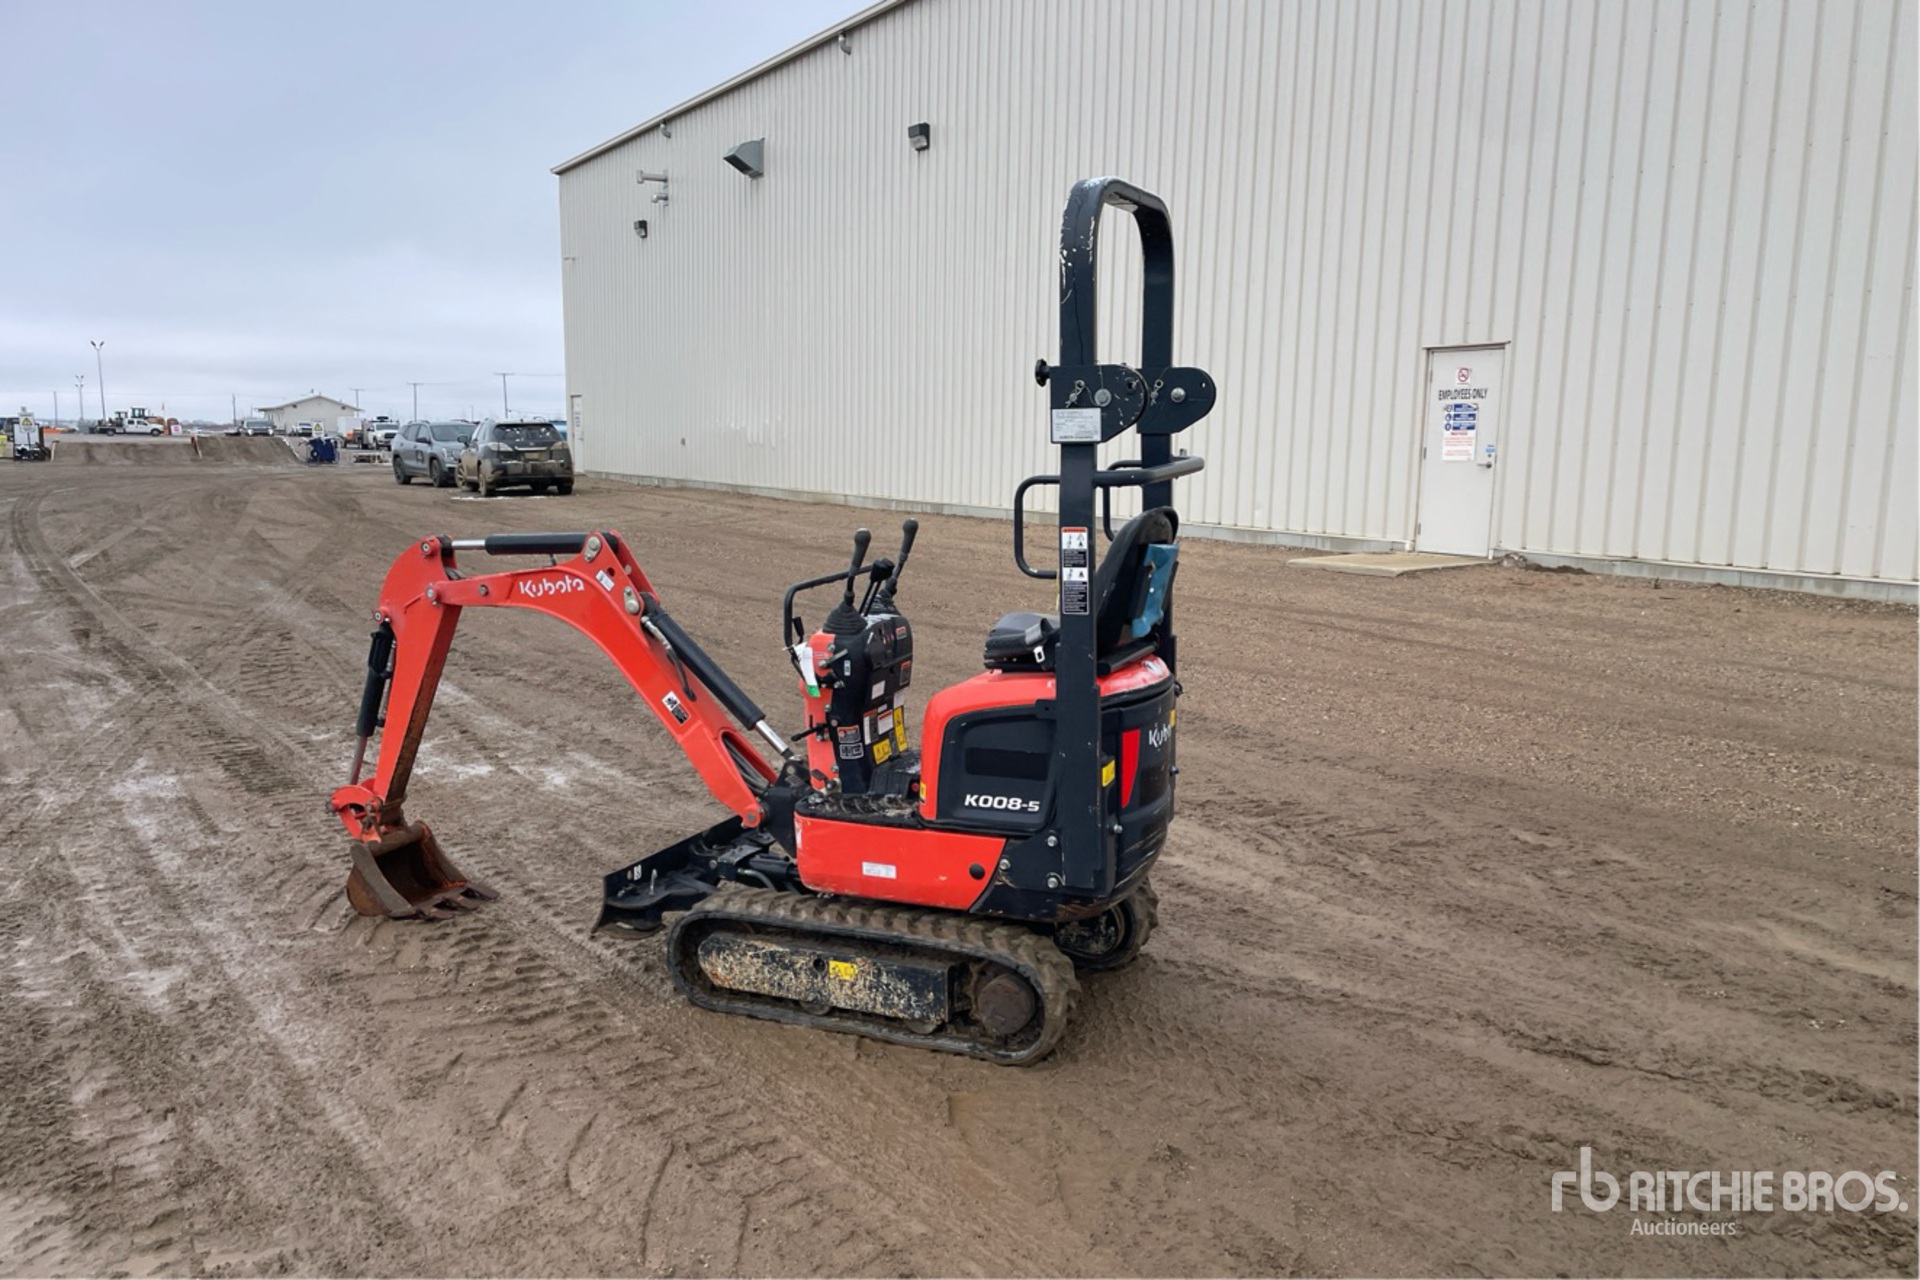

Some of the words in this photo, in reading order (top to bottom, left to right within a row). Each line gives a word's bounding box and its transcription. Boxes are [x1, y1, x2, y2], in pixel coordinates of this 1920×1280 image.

[1438, 388, 1471, 400] EMPLOYEES
[1472, 387, 1488, 399] ONLY
[519, 575, 584, 598] Kubota
[964, 794, 1041, 812] K008-5
